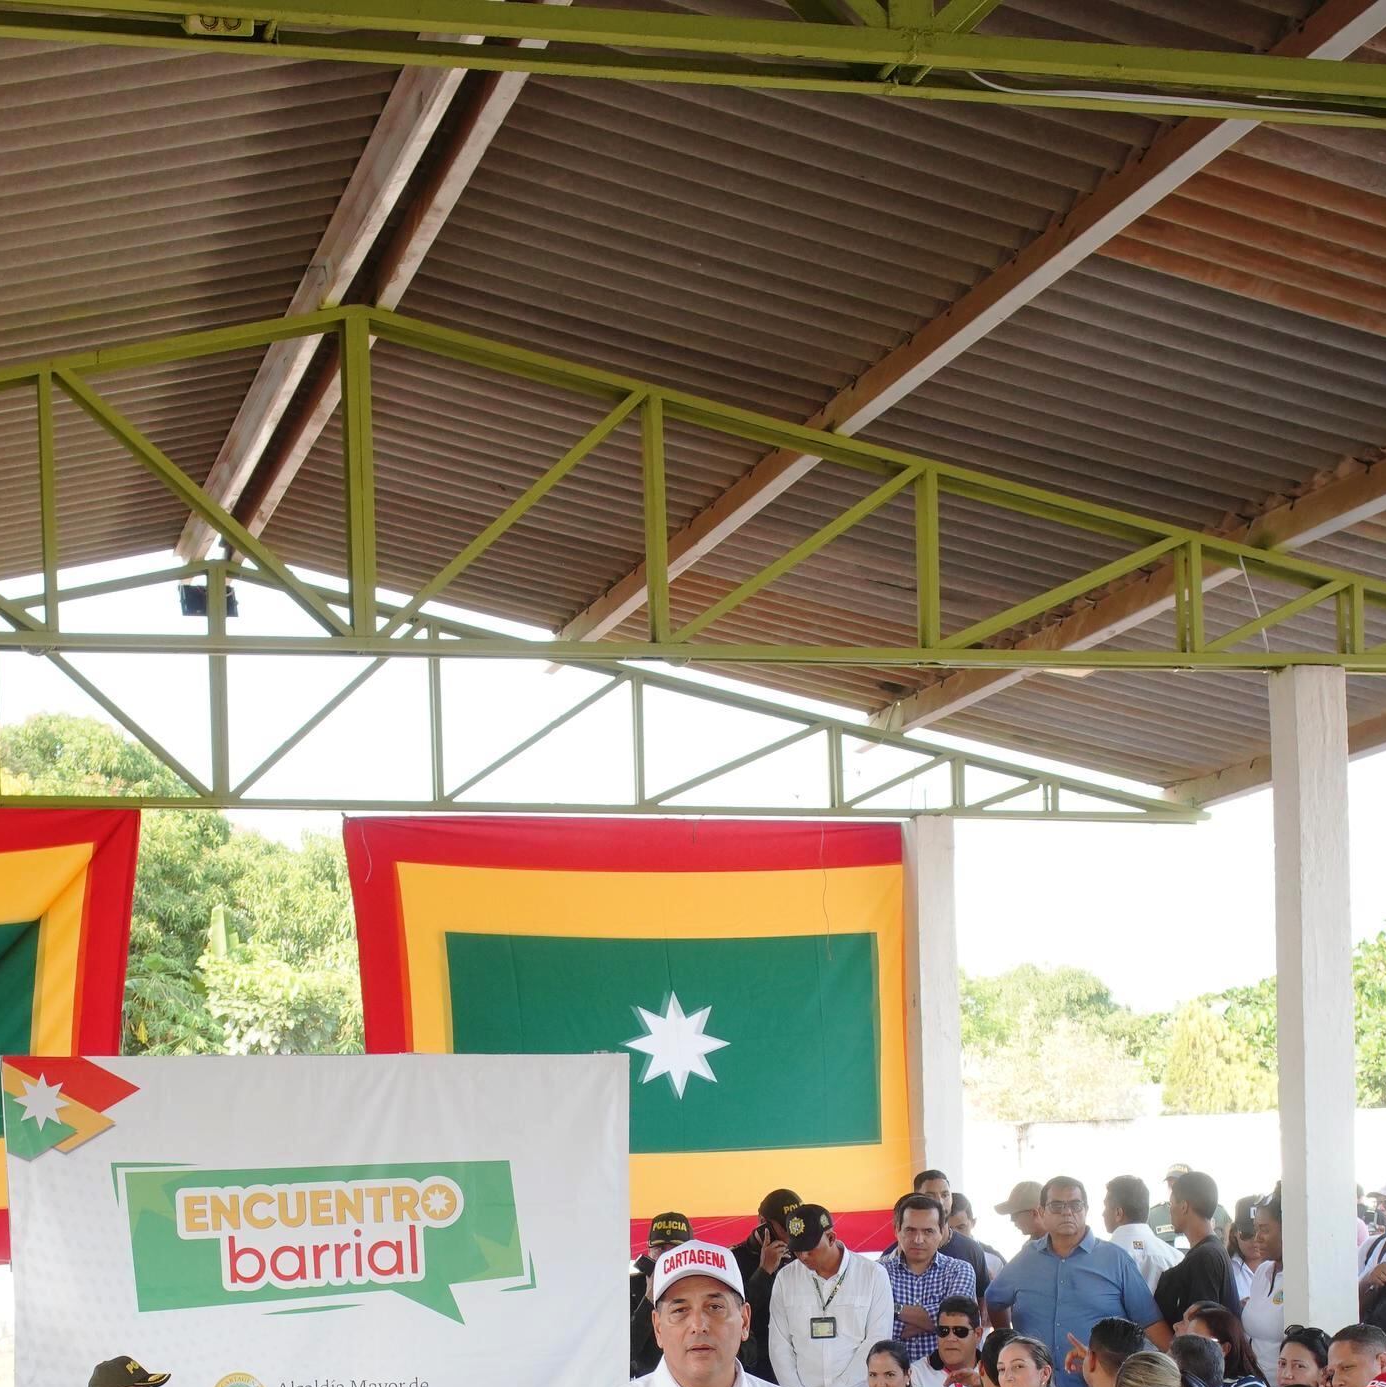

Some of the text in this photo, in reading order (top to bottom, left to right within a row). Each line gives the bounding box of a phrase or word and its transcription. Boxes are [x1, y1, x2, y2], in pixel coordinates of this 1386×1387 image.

[183, 1184, 457, 1232] ENCUENTRO
[653, 1221, 687, 1232] POLICIA
[228, 1224, 418, 1284] barrial
[664, 1249, 727, 1275] CARTAGENA
